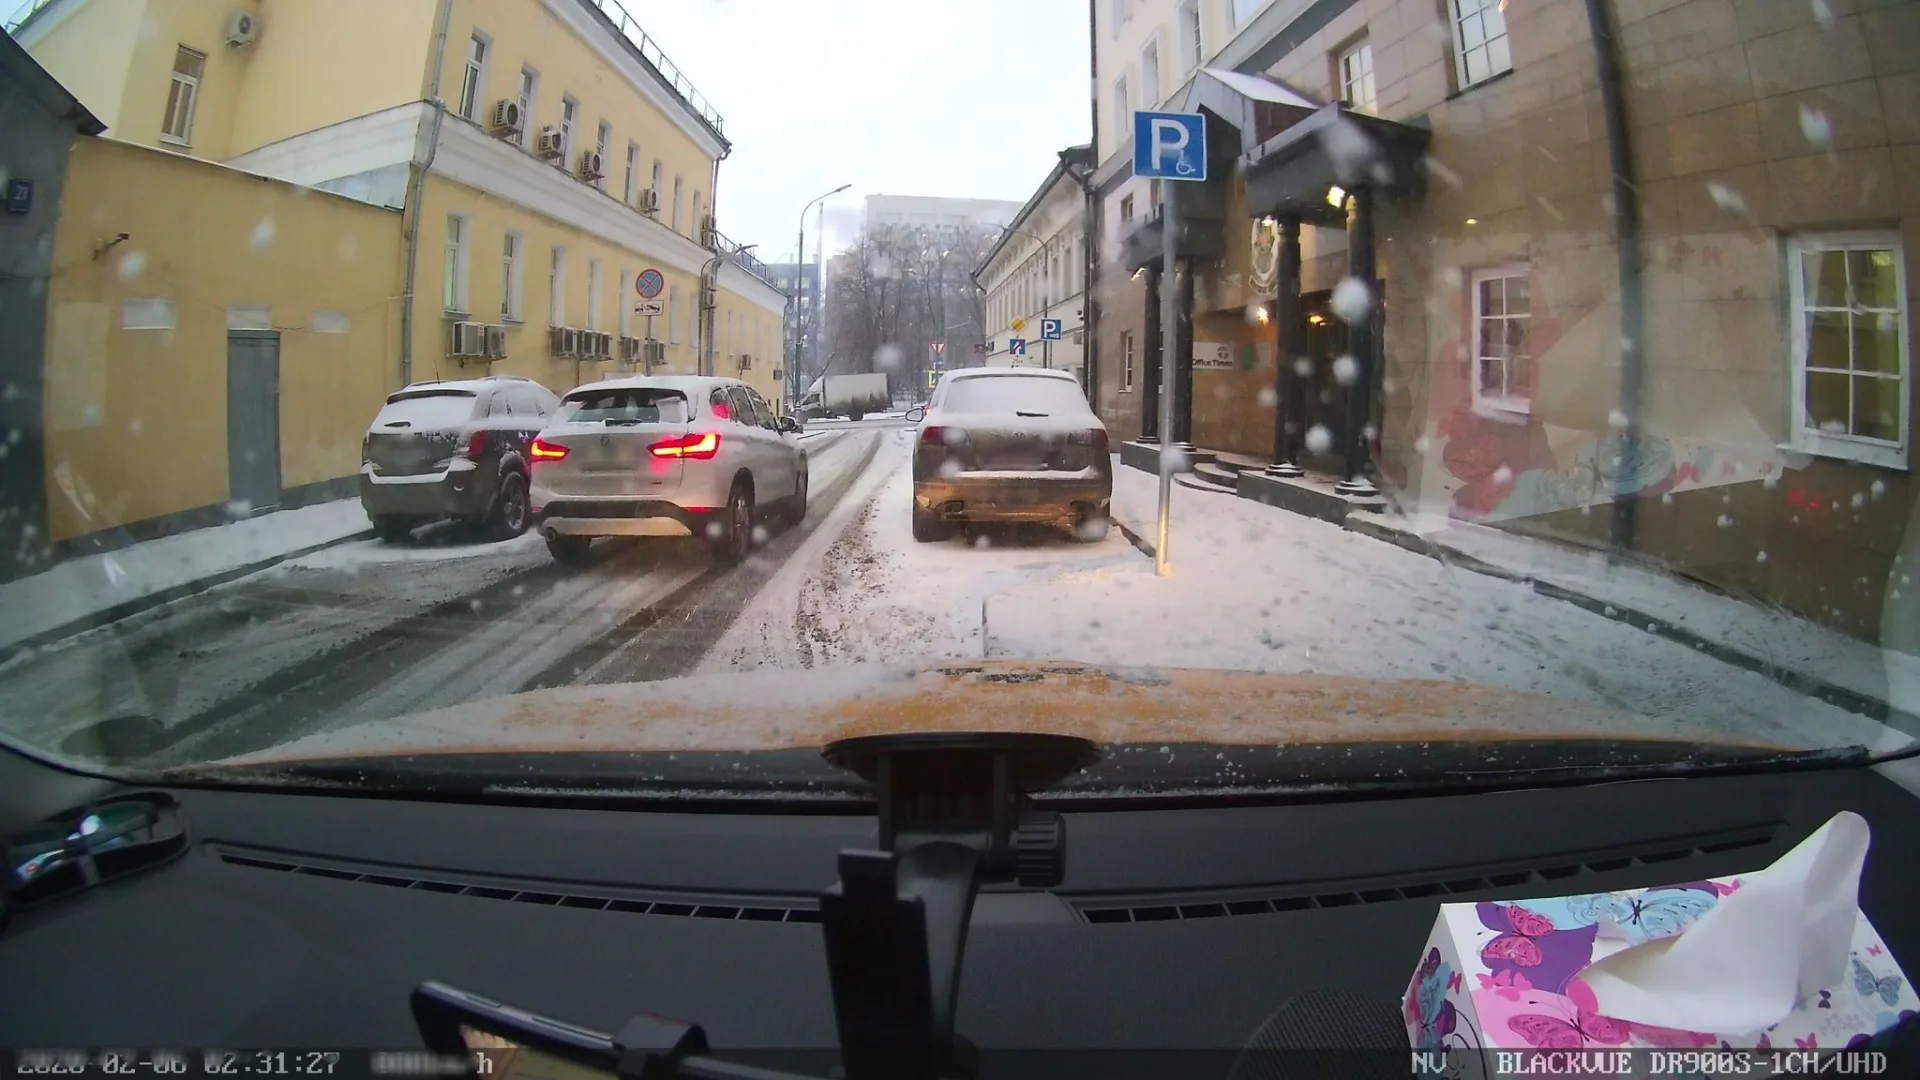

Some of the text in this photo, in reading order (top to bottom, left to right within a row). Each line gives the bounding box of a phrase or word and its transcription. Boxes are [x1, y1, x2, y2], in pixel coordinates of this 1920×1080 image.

[1151, 118, 1190, 171] P
[14, 184, 29, 200] 21
[1044, 321, 1056, 338] P
